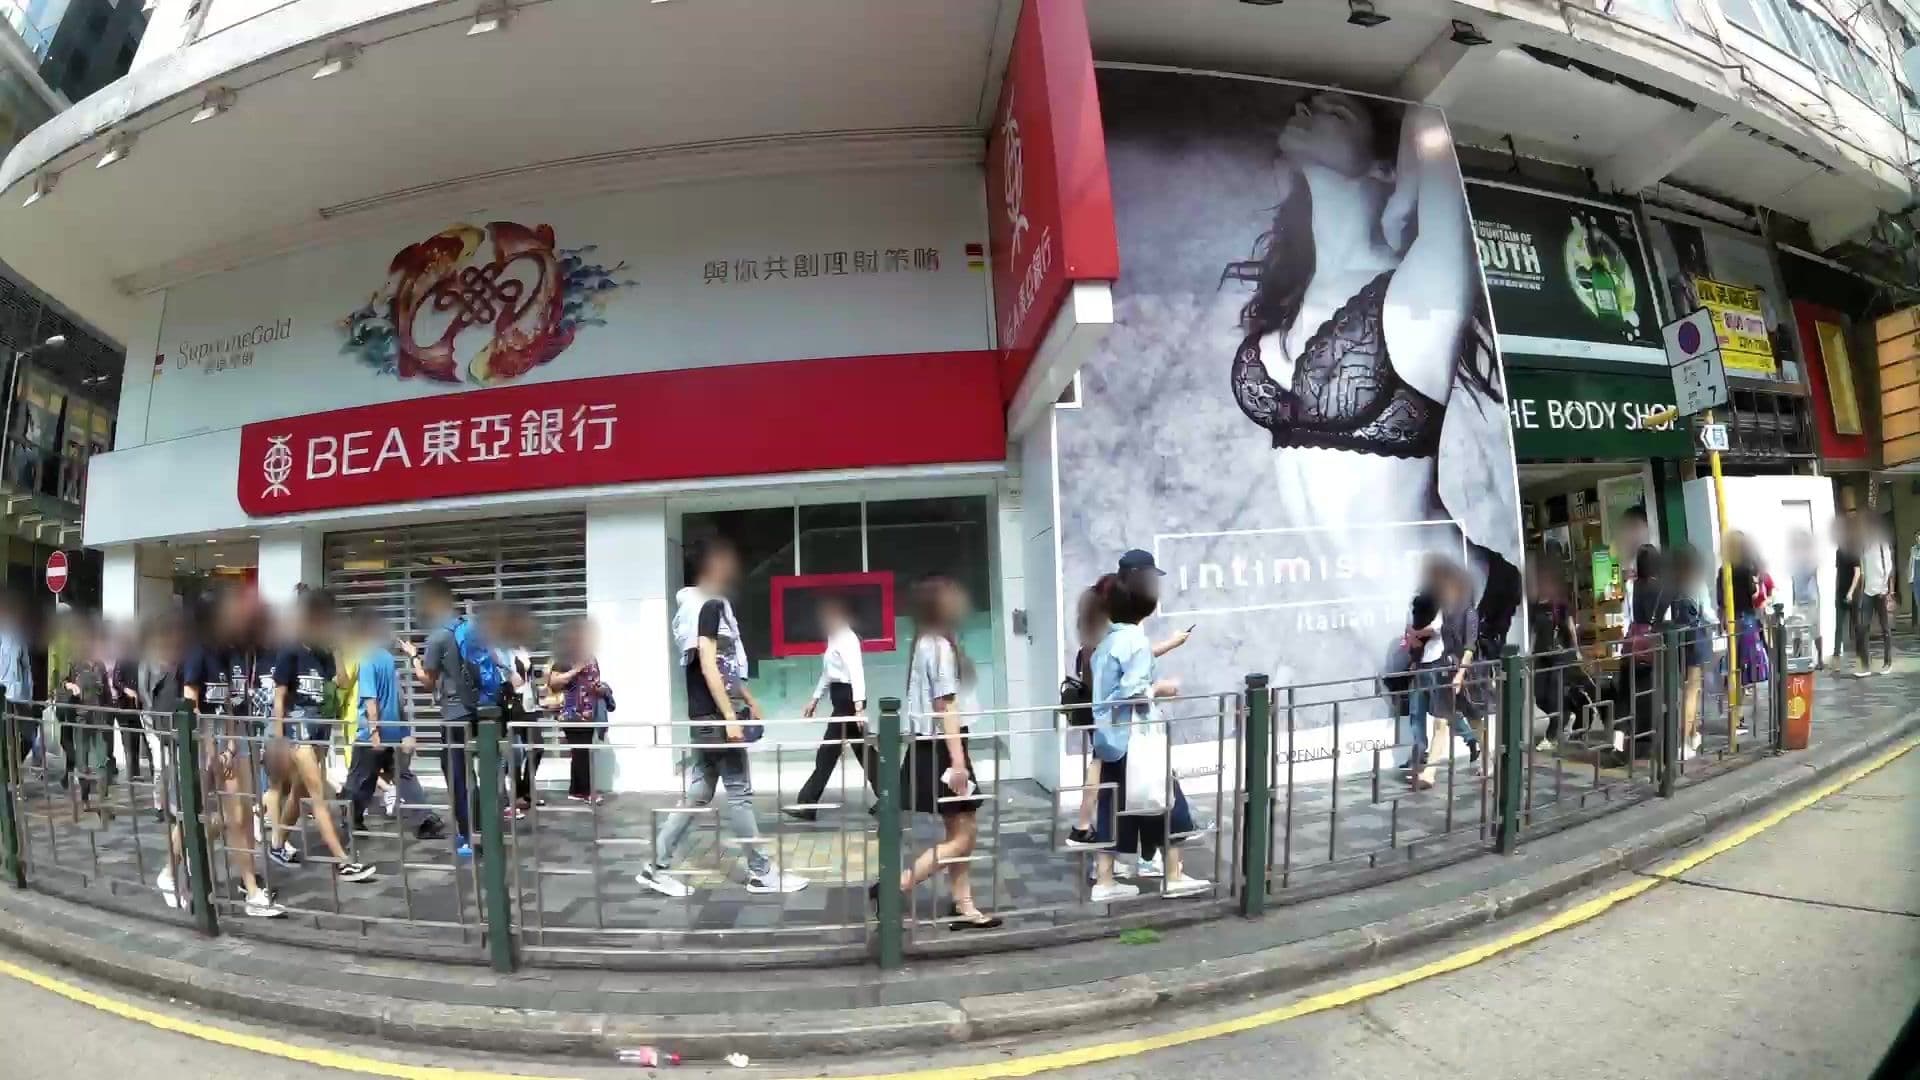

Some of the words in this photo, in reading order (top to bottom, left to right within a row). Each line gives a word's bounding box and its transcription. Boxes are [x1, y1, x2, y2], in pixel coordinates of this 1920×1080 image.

[1520, 232, 1535, 245] OF
[1703, 359, 1711, 375] 7
[1707, 385, 1717, 403] 7
[1548, 399, 1616, 430] BODY
[306, 426, 412, 481] BEA
[420, 403, 618, 467] 東亞銀行
